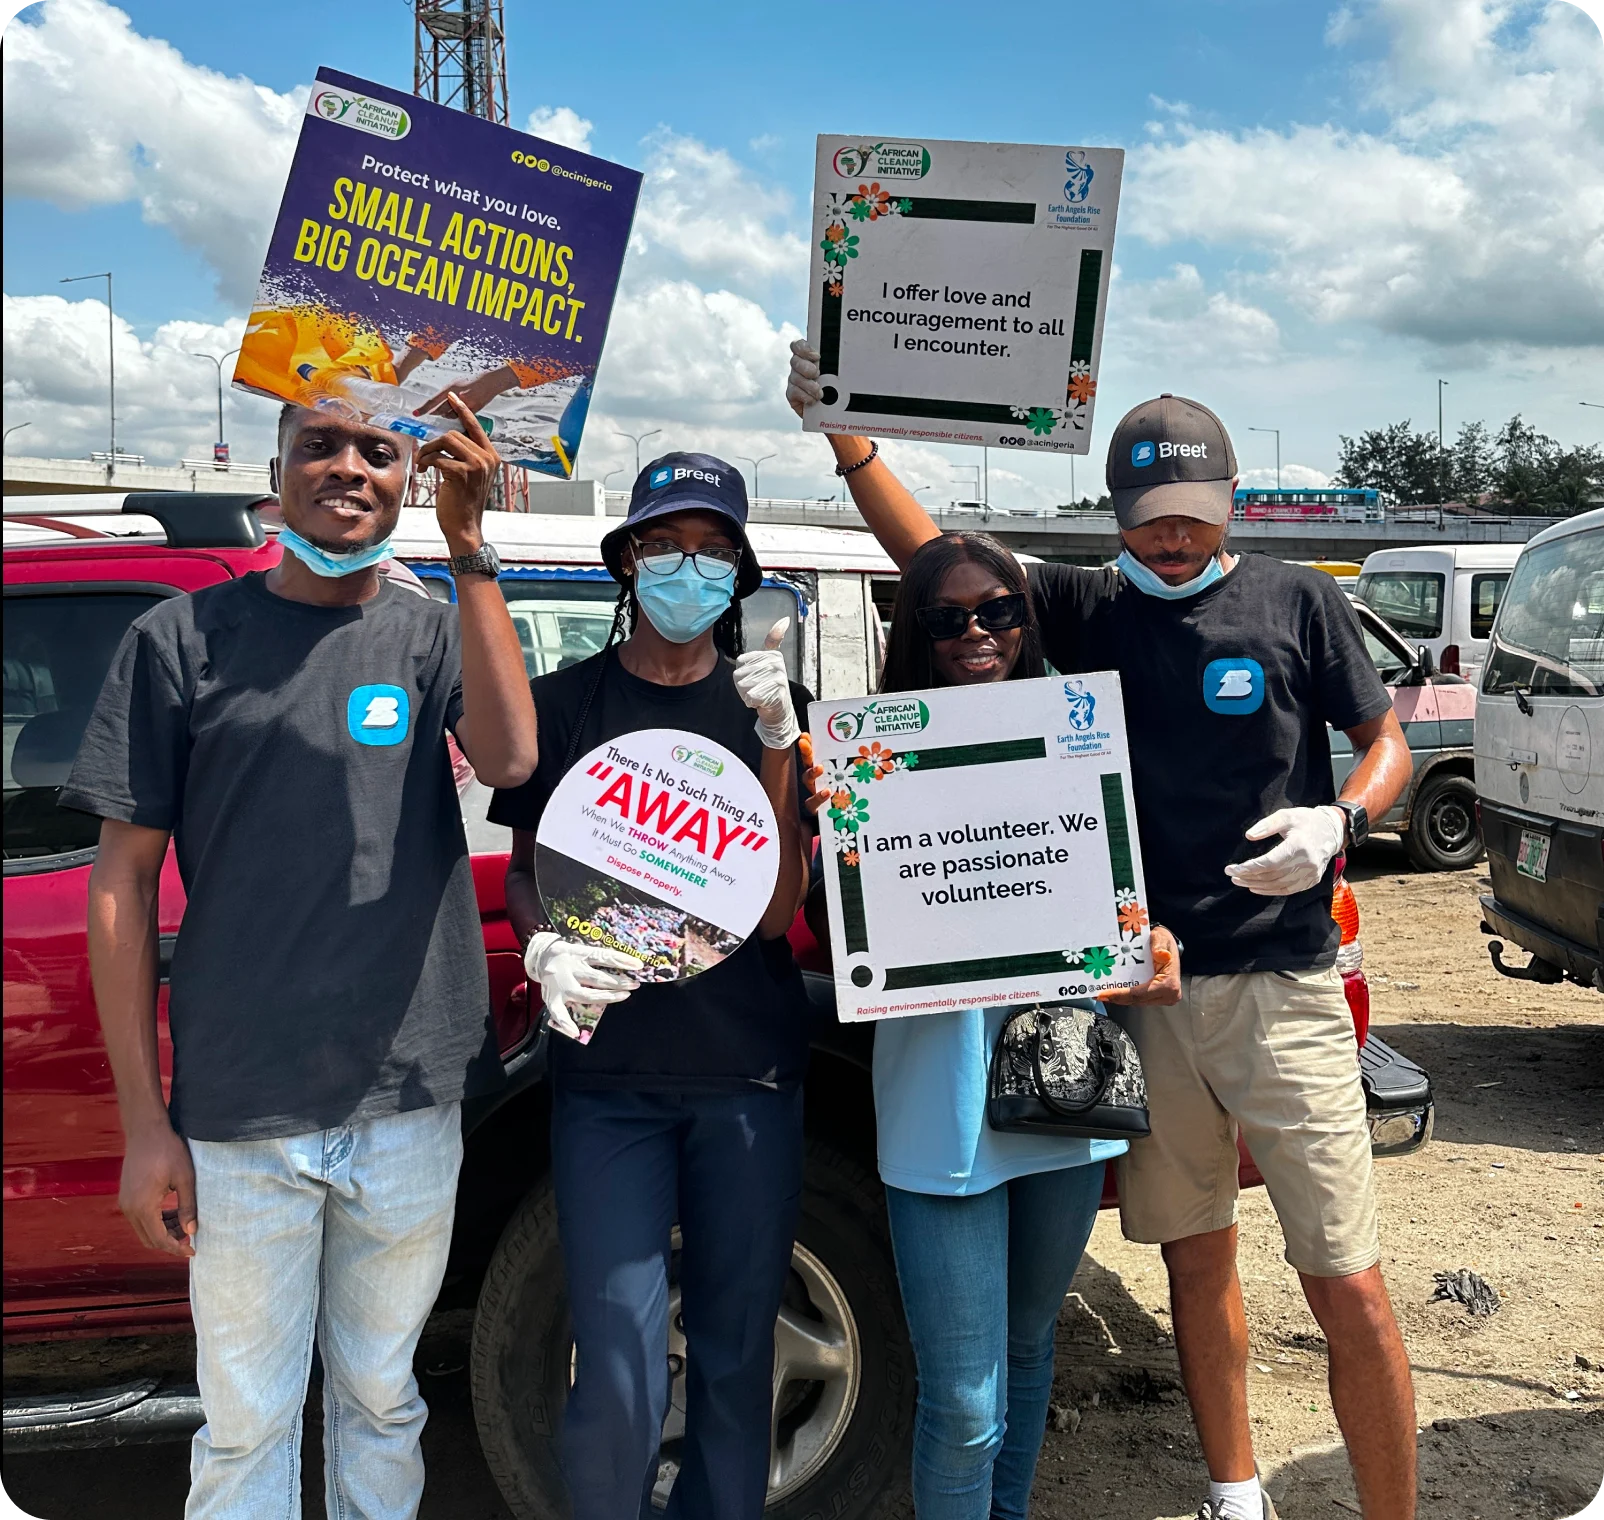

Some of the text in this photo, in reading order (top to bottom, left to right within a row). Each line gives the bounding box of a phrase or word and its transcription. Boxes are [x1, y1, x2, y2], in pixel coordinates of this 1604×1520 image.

[357, 110, 399, 127] CLEANUP
[362, 103, 398, 118] AFRICAN
[356, 116, 397, 135] INITIATIVE
[878, 158, 921, 166] CLEANUP
[882, 149, 919, 158] AFRICAN
[551, 165, 613, 192] @acinigeria
[878, 166, 920, 175] INITIATIVE
[362, 154, 562, 232] Protect what you love.
[1048, 204, 1101, 214] Earth Angels Rise
[1056, 214, 1091, 223] Foundation
[328, 177, 575, 292] SMALL ACTIONS,
[294, 218, 586, 344] BIG OCEAN IMPACT.
[882, 282, 1031, 308] I offer love and
[847, 308, 1065, 336] encouragement to all
[893, 333, 1011, 358] I encounter.
[819, 422, 984, 442] Raising environmentally responsible citizens.
[1027, 439, 1075, 450] @acinigeria
[1158, 442, 1207, 459] Breet
[674, 468, 721, 487] Breet
[874, 713, 920, 723] CLEANUP
[877, 704, 916, 714] AFRICAN
[876, 721, 920, 732] INITIATIVE
[1057, 731, 1110, 743] Earth Angels Rise
[1068, 742, 1102, 752] Foundation
[693, 762, 716, 775] INITIATIVE
[696, 757, 719, 770] CLEANUP
[700, 754, 719, 765] AFRICAN
[606, 746, 764, 829] There Is No Such Thing As
[863, 813, 1098, 853] I am a volunteer. We
[581, 805, 737, 886] When We THROW Anything Away.
[592, 828, 708, 888] It Must Go SOMEWHERE
[899, 845, 1069, 879] are passionate
[607, 855, 682, 897] Dispose Properly.
[921, 880, 1053, 906] volunteers.
[857, 990, 1042, 1016] Raising environmentally responsible citizens.
